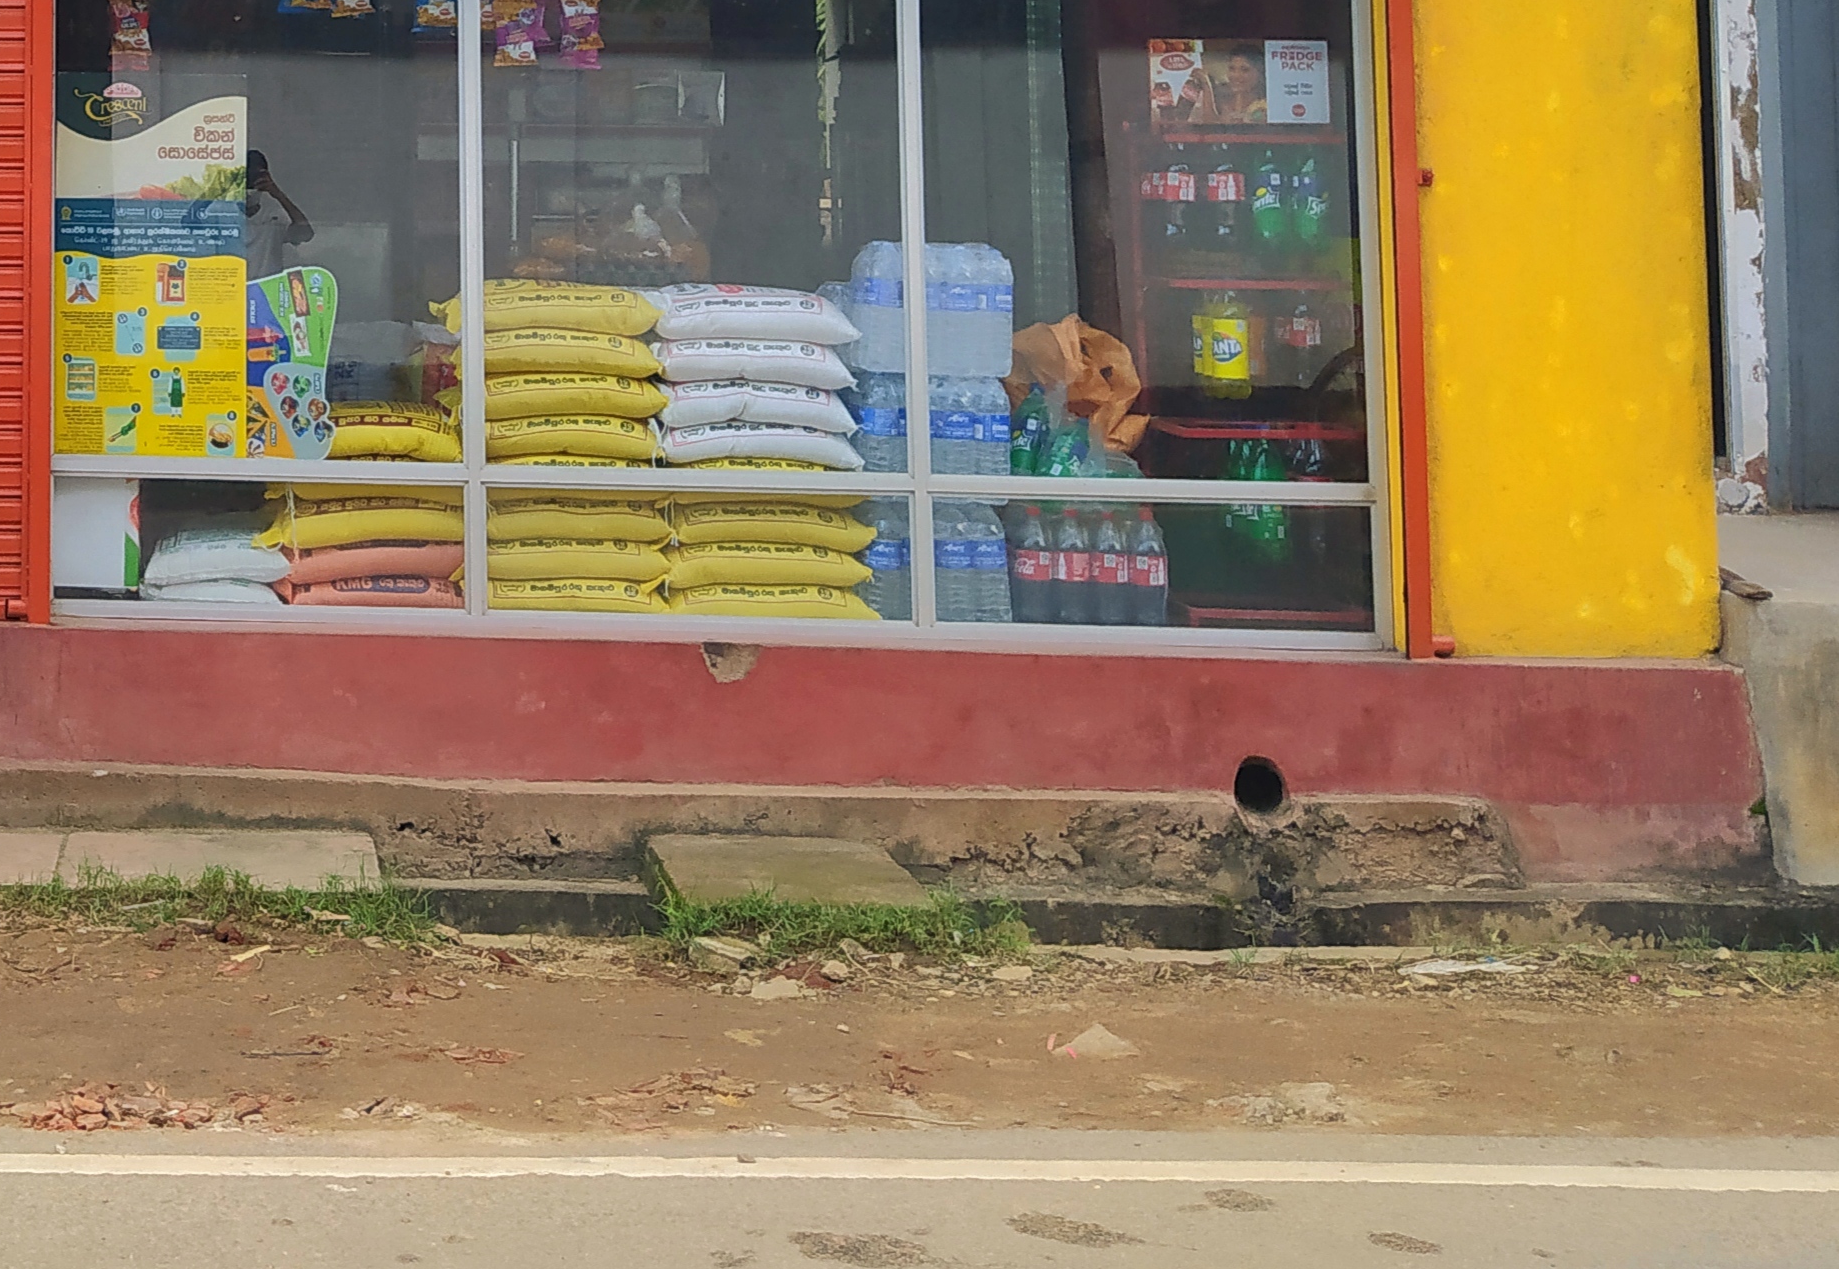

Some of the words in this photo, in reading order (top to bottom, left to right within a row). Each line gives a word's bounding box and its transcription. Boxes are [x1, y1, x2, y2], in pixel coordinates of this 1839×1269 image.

[1271, 50, 1323, 61] FRIDGE
[1281, 62, 1314, 71] PACK
[193, 126, 235, 143] චිකන්
